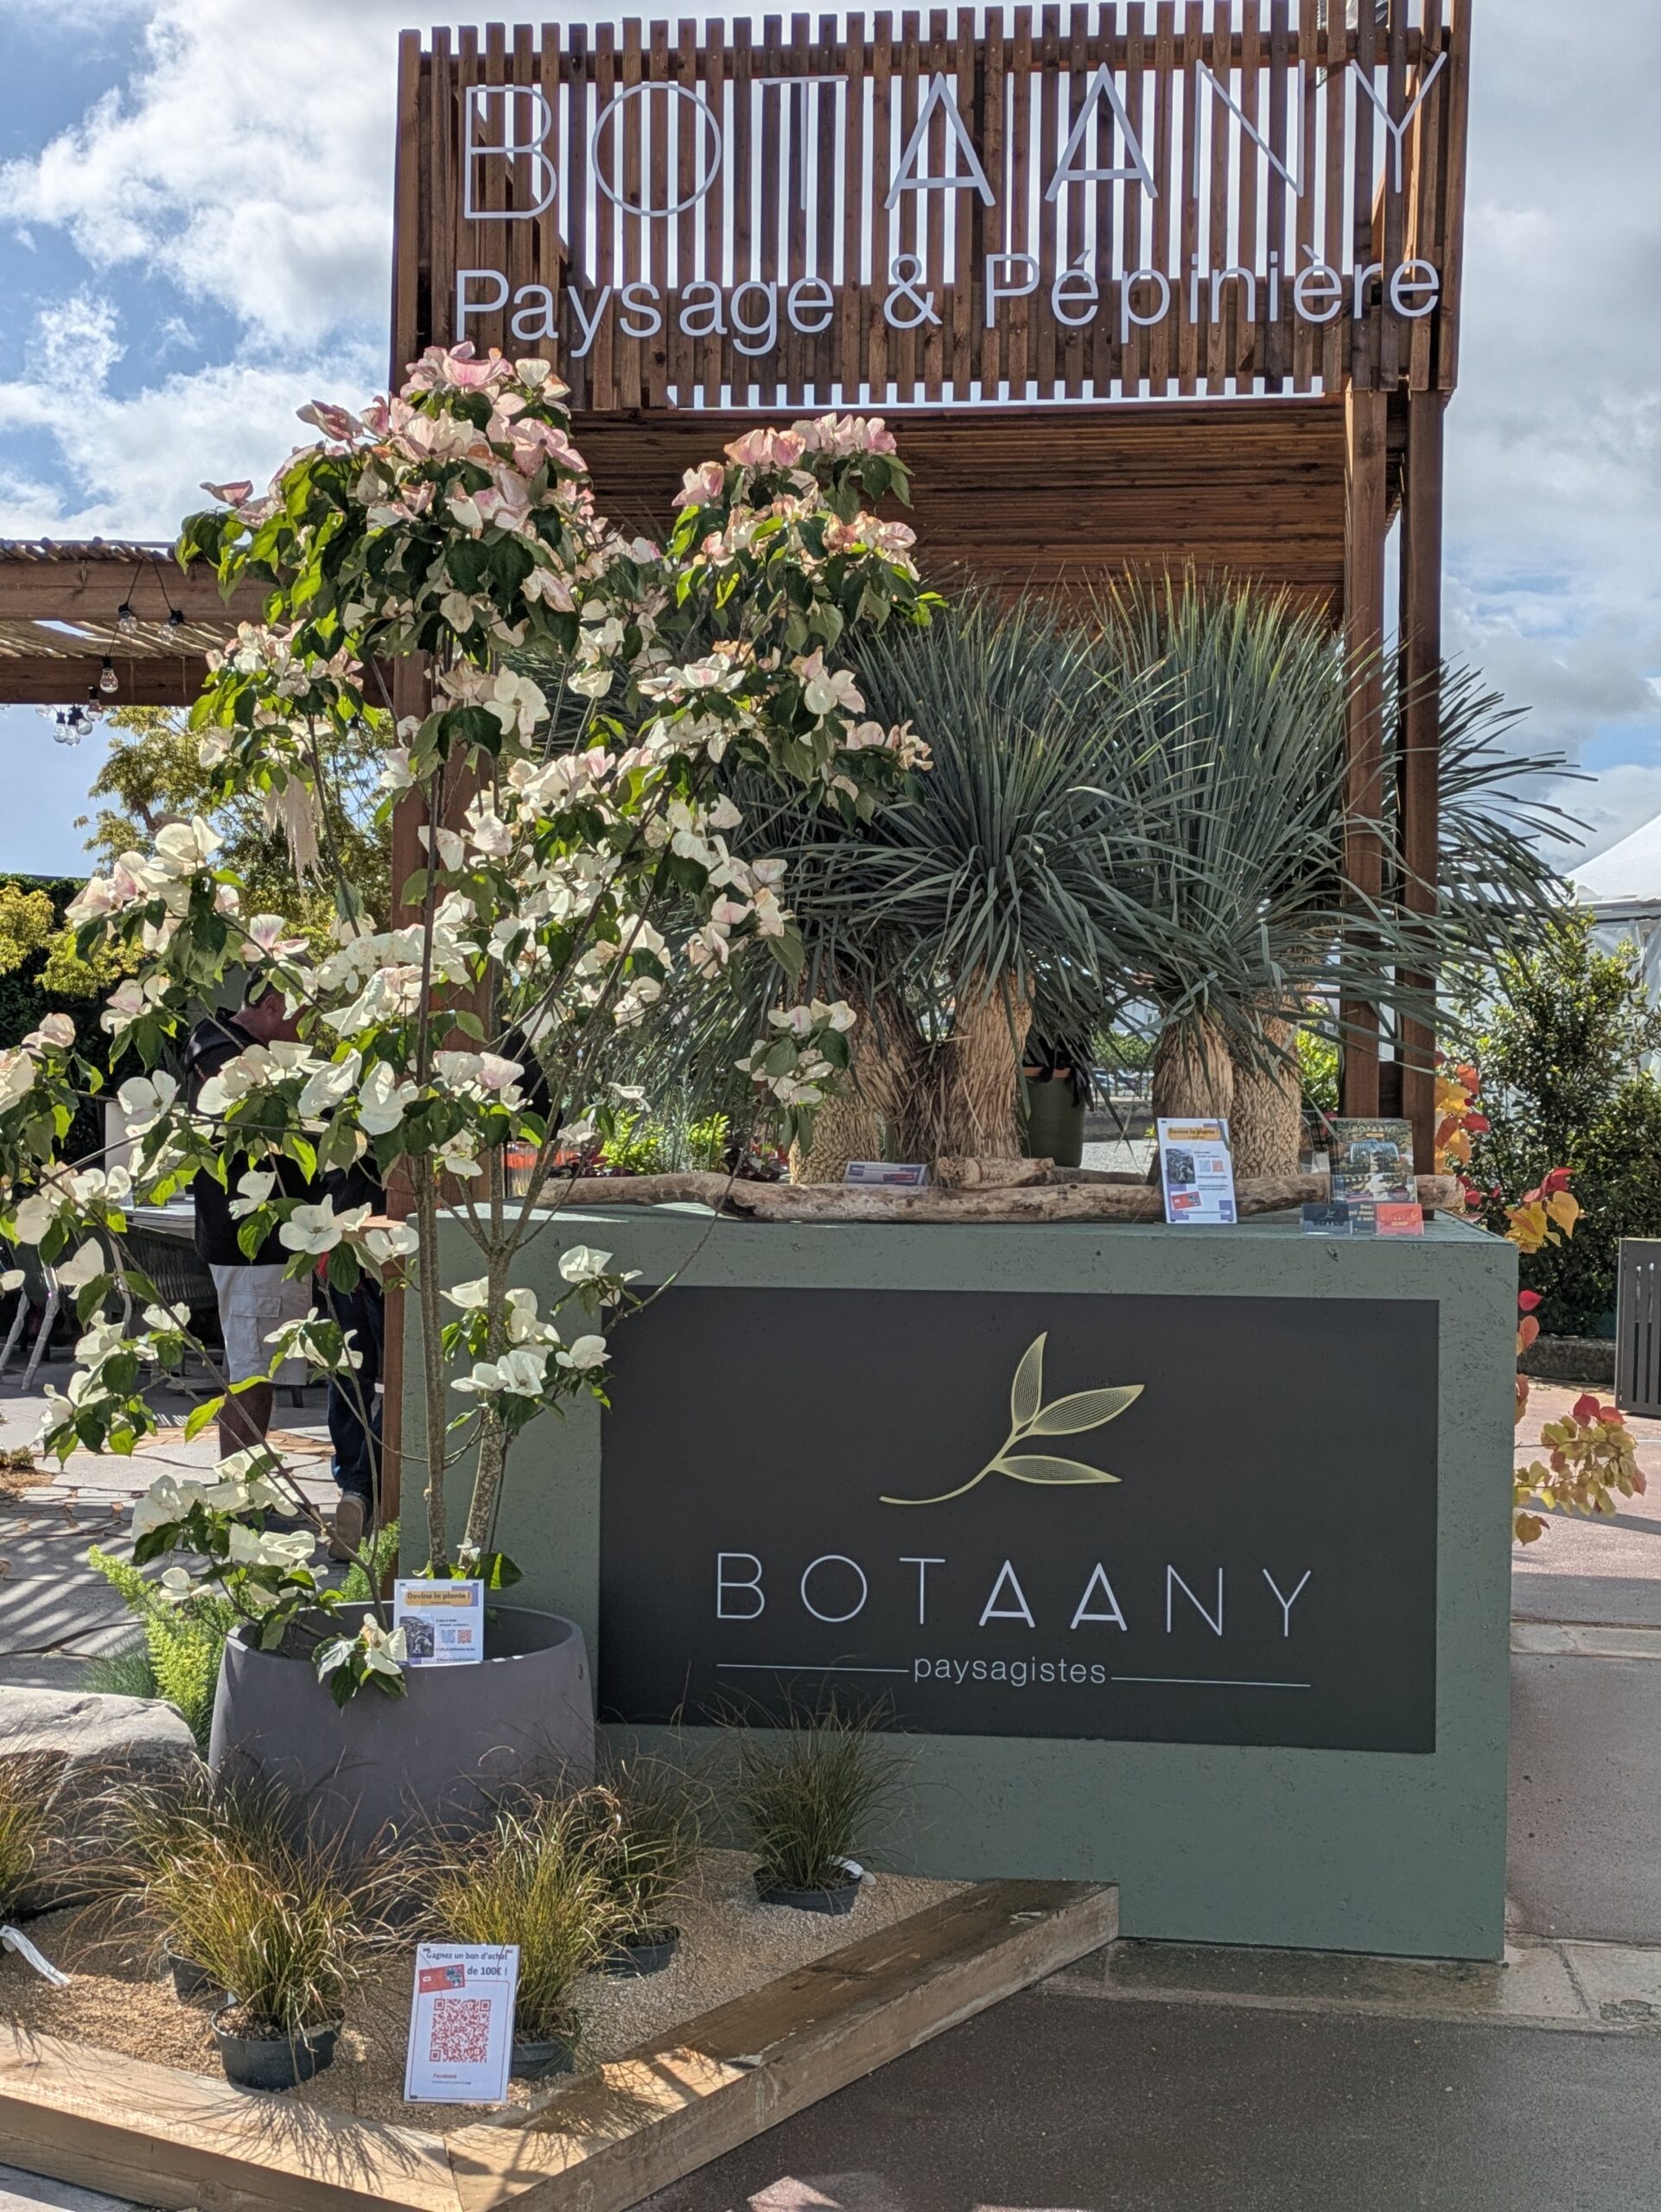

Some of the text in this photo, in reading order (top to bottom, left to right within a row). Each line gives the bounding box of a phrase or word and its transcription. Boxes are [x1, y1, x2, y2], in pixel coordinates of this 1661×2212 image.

[463, 51, 1448, 219] BOTAANY
[455, 244, 1440, 358] Paysage & Pépinière
[716, 1551, 1312, 1637] BOTAANY
[914, 1656, 1106, 1687] paysagistes
[426, 1952, 453, 1961] Gagnez
[467, 1967, 479, 1975] de
[480, 1967, 502, 1976] 100€
